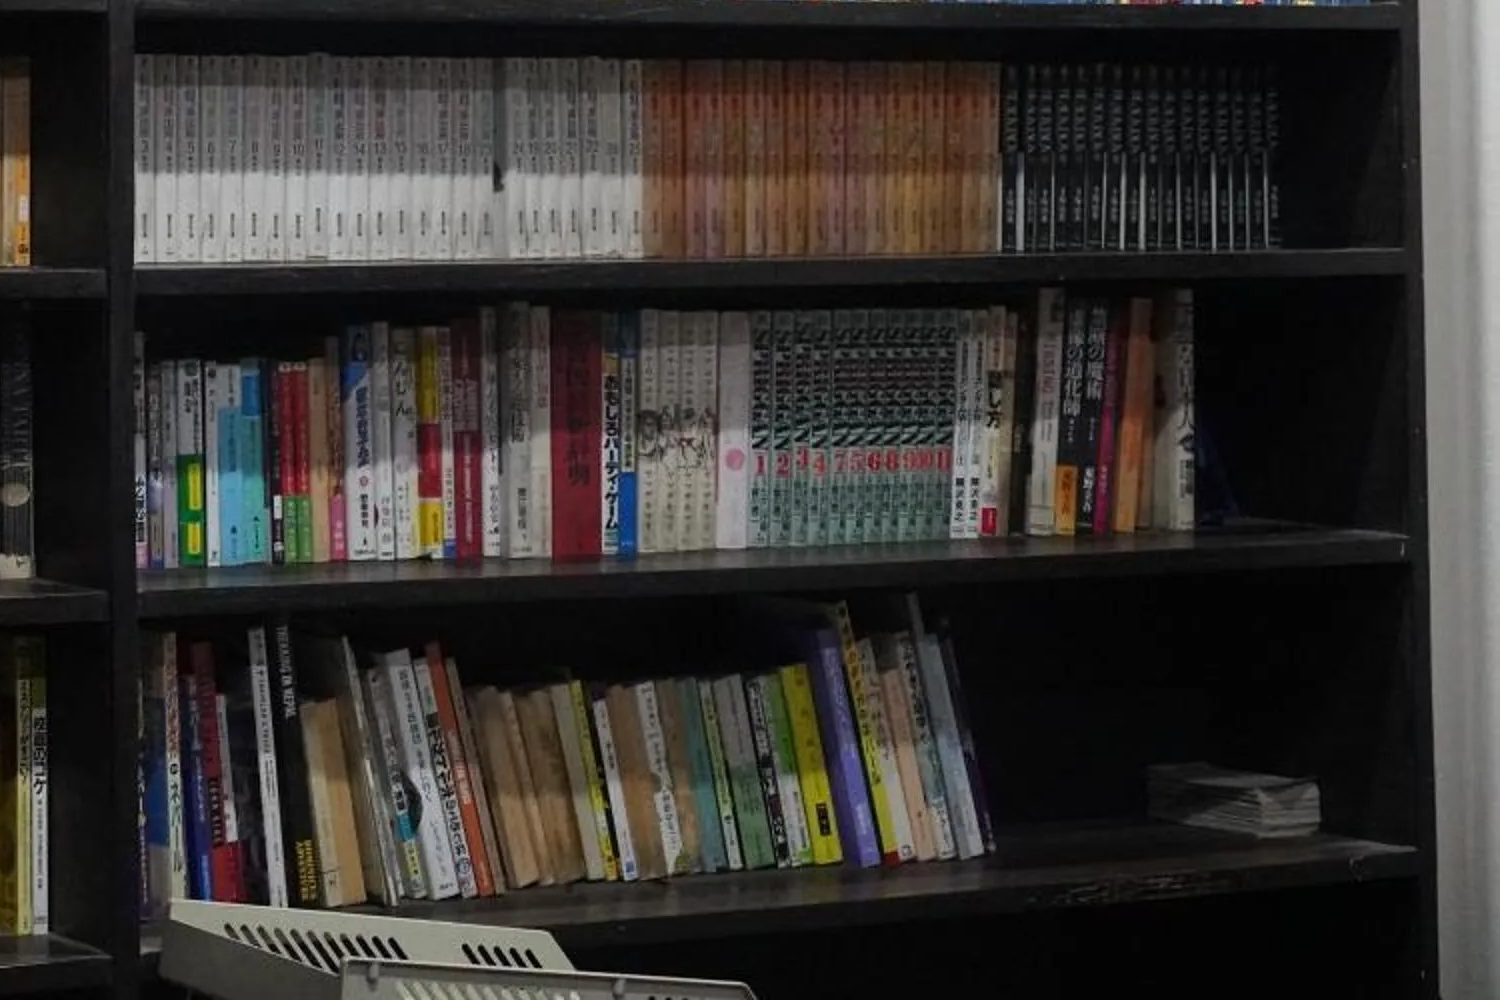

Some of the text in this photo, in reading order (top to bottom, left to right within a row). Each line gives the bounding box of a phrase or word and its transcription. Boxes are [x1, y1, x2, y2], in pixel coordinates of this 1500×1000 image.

[755, 456, 766, 474] 1
[776, 455, 791, 477] 2
[867, 451, 881, 473] 6
